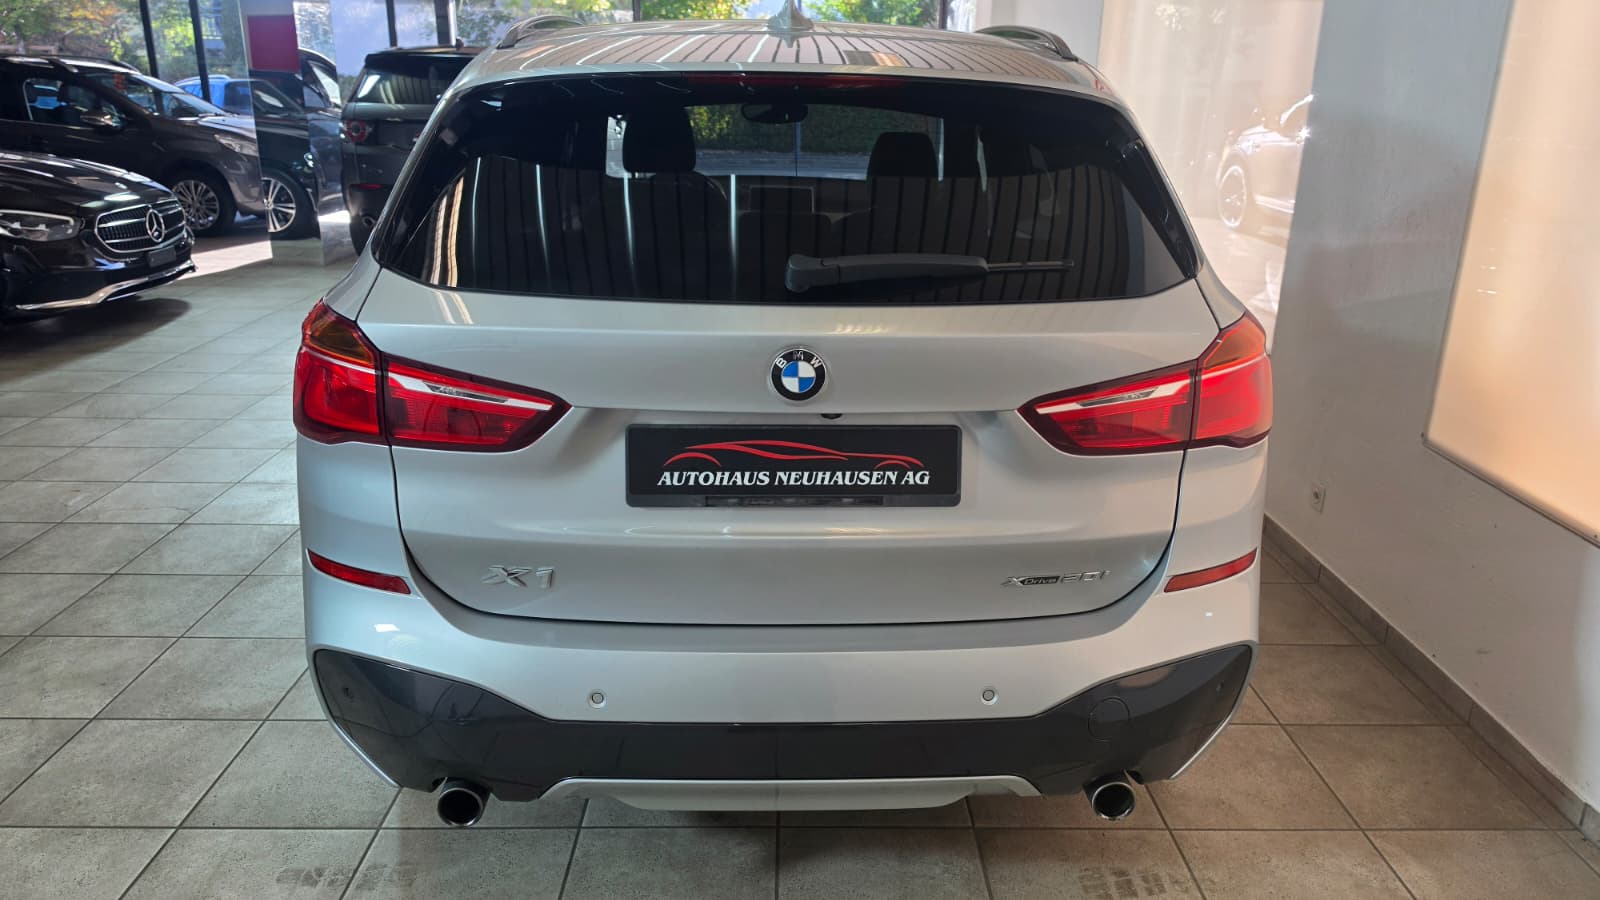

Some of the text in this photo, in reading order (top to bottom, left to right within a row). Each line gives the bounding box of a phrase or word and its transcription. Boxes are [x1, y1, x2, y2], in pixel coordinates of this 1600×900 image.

[775, 350, 822, 369] BMW
[657, 470, 930, 486] AUTOHAUS NEUHAUSEN AG
[481, 565, 555, 589] X1
